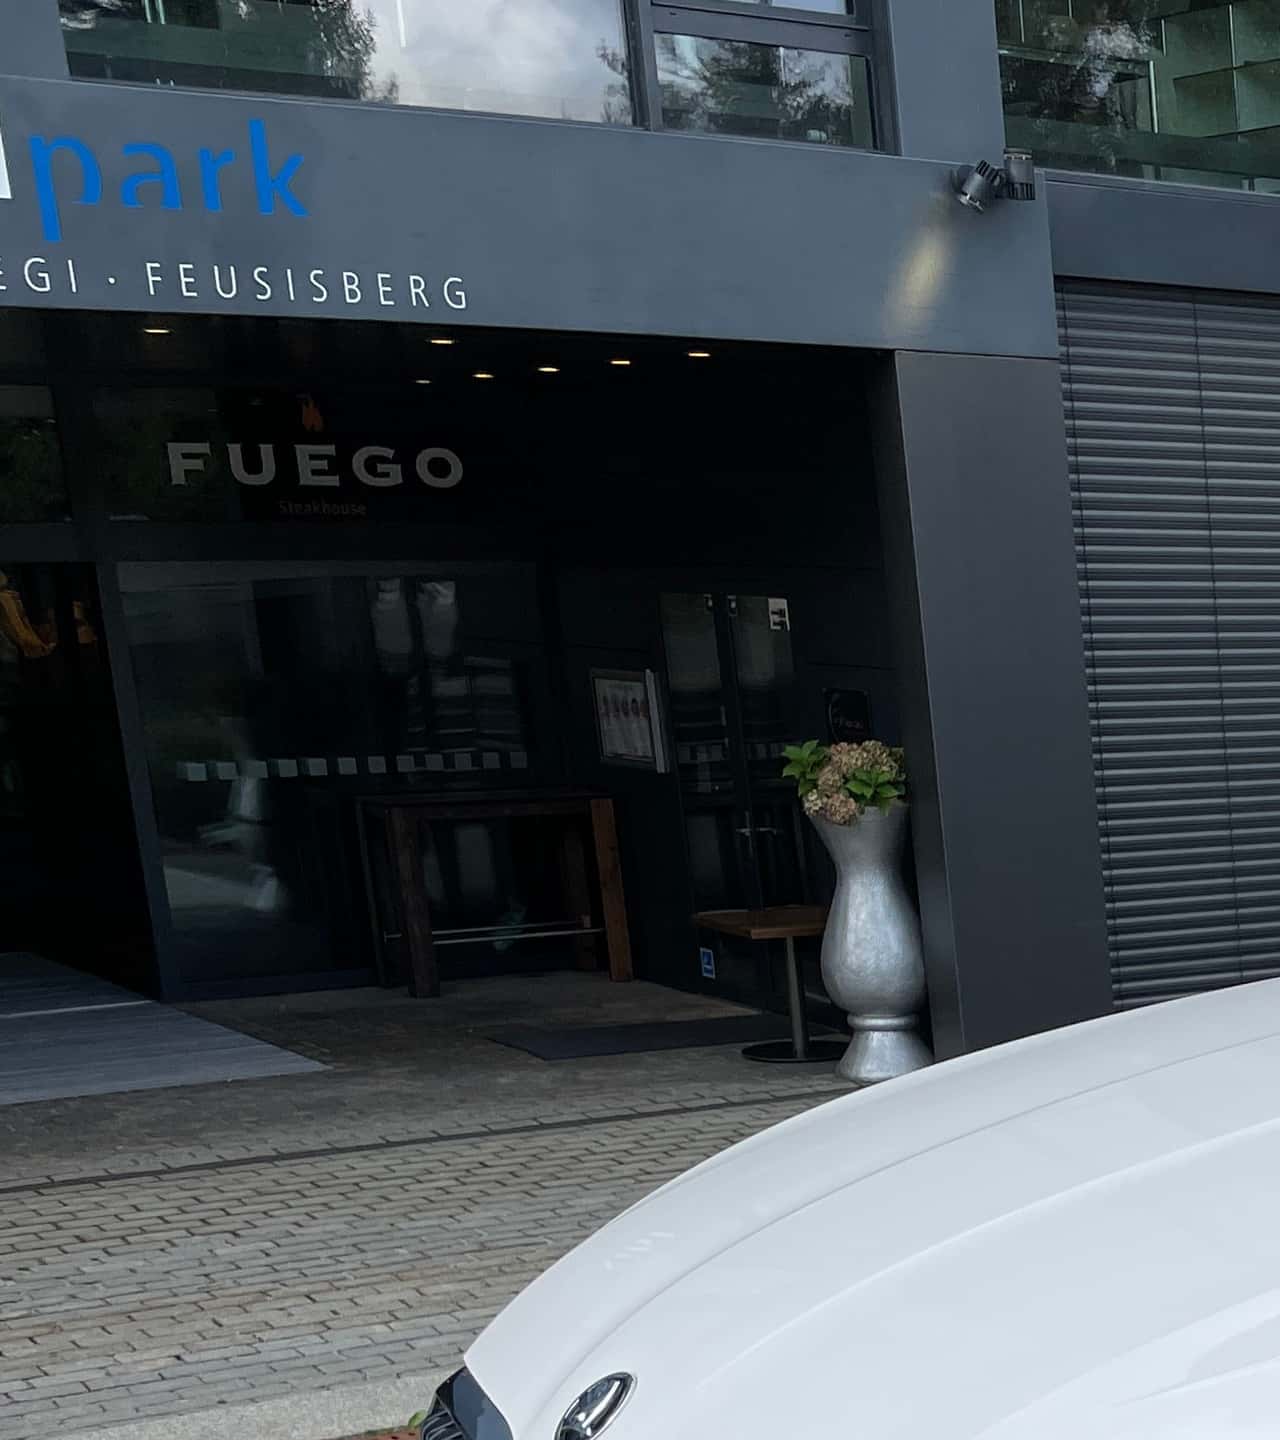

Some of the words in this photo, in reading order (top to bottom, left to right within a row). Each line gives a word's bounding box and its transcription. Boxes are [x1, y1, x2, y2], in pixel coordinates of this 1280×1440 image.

[145, 263, 468, 309] FEUSISBERG
[166, 441, 464, 488] FUEGO
[279, 499, 367, 517] Steakhouse
